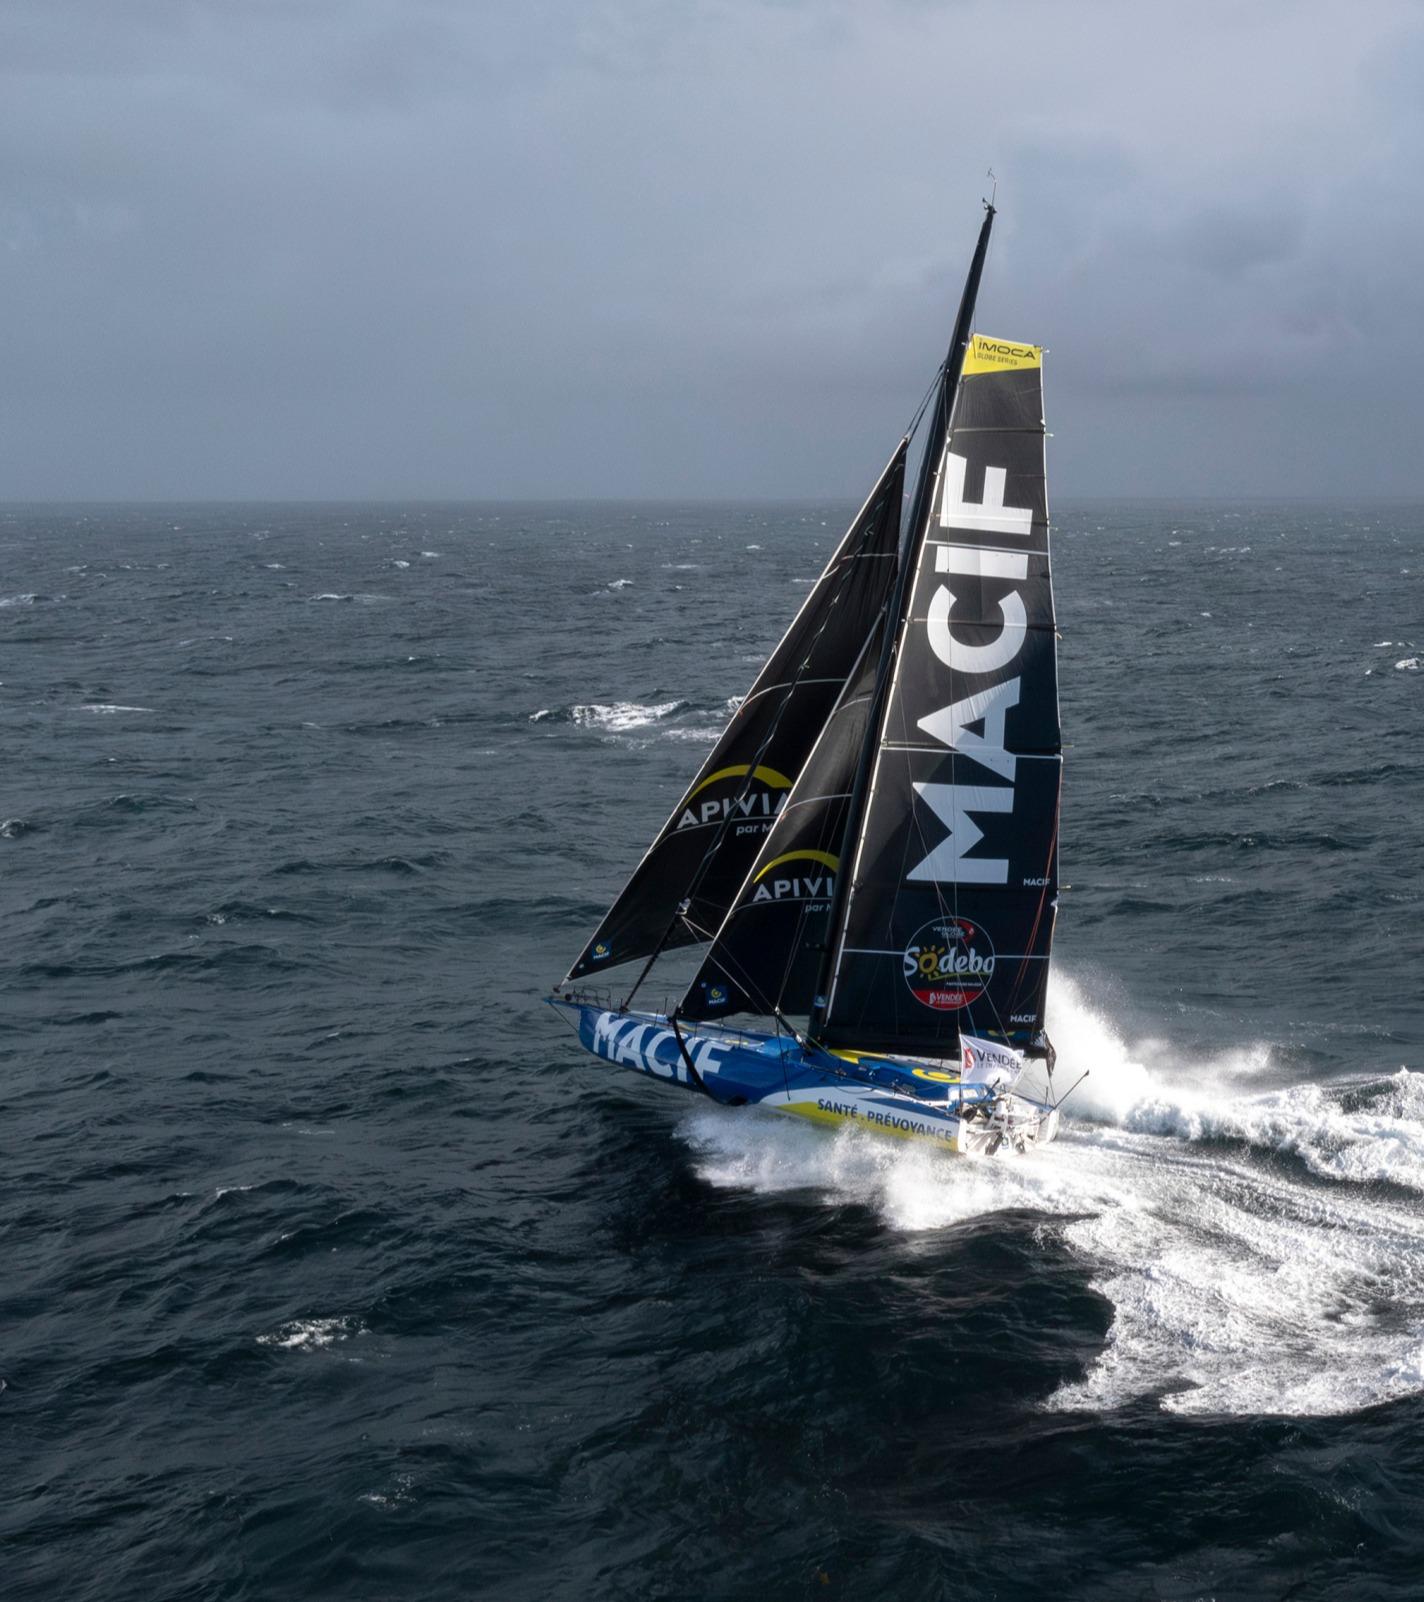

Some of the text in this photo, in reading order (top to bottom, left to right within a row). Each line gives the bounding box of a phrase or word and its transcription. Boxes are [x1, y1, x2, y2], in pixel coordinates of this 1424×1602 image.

[906, 452, 1033, 884] MACIF
[736, 823, 759, 837] par
[1023, 878, 1050, 887] MACIF
[805, 903, 824, 913] par
[903, 946, 995, 977] Sodebo
[1010, 1014, 1037, 1023] MACIF
[593, 1011, 733, 1083] MACIF
[817, 1098, 858, 1118] SANTÉ
[867, 1110, 952, 1142] PRÉVOYANCE
